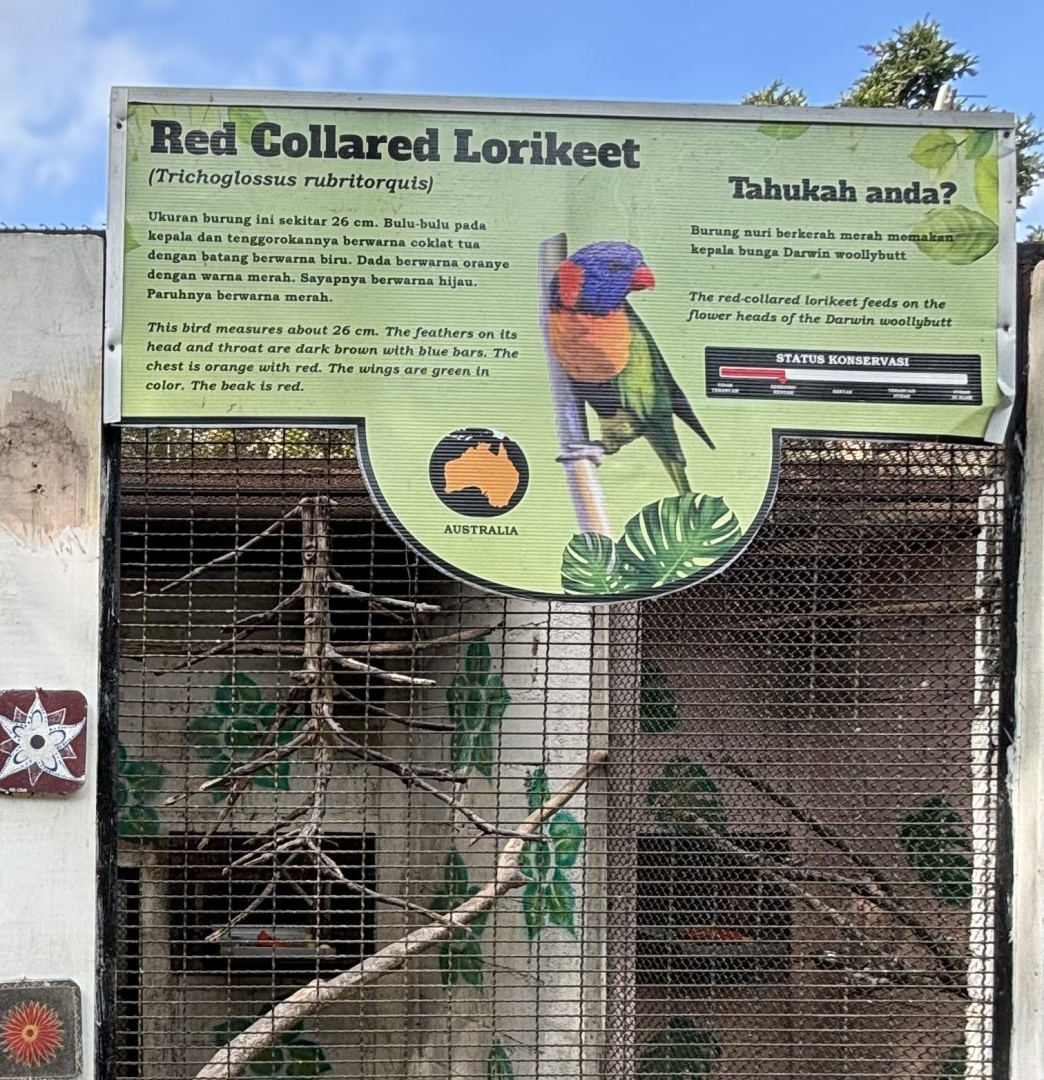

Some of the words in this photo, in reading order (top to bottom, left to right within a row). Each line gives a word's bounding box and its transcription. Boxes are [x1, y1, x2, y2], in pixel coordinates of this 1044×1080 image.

[150, 116, 238, 156] Red
[249, 121, 441, 162] Collared
[453, 128, 641, 169] Lorikeet
[148, 167, 298, 189] (Trichoglossus
[304, 172, 434, 195] rubritorquis)
[727, 175, 858, 203] Tahukah
[865, 181, 958, 206] anda?
[147, 210, 199, 223] Ukuran
[202, 212, 252, 228] burung
[255, 213, 275, 225] ini
[278, 214, 328, 227] sekitar
[331, 216, 350, 227] 26
[353, 219, 379, 228] cm.
[383, 217, 450, 230] Bulu-bulu
[454, 219, 487, 233] pada
[690, 243, 735, 258] kepala
[737, 245, 780, 260] bunga
[782, 246, 831, 259] Darwin
[834, 248, 907, 263] woollybutt
[146, 288, 213, 303] Paruhnya
[216, 289, 281, 302] berwarna
[284, 291, 333, 303] merah.
[688, 290, 715, 303] The
[718, 292, 802, 305] red-collared
[804, 294, 859, 307] lorikeet
[859, 296, 899, 311] feeds
[901, 300, 920, 309] on
[923, 298, 947, 310] the
[685, 308, 733, 323] flower
[735, 310, 778, 323] heads
[780, 312, 797, 326] of
[798, 312, 822, 324] the
[824, 313, 876, 326] Darwin
[879, 315, 953, 330] woollybutt
[147, 321, 178, 333] This
[181, 322, 212, 334] bird
[215, 325, 284, 335] measures
[287, 324, 329, 336] about
[331, 325, 351, 336] 26
[354, 327, 379, 337] cm.
[385, 326, 411, 338] The
[412, 326, 474, 340] feathers
[477, 330, 495, 340] on
[499, 328, 518, 340] its
[145, 360, 184, 372] chest
[188, 360, 201, 372] is
[204, 363, 255, 375] orange
[258, 361, 291, 373] with
[295, 362, 323, 373] red.
[327, 362, 355, 374] The
[358, 363, 400, 377] wings
[403, 366, 428, 376] are
[431, 367, 472, 378] green
[475, 365, 490, 377] in
[775, 353, 826, 365] STATUS
[828, 354, 910, 367] KONSERVASI
[145, 379, 185, 391] color.
[190, 380, 217, 391] The
[220, 380, 256, 391] beak
[260, 380, 273, 392] is
[277, 380, 305, 392] red.
[443, 524, 520, 536] AUSTRALIA
